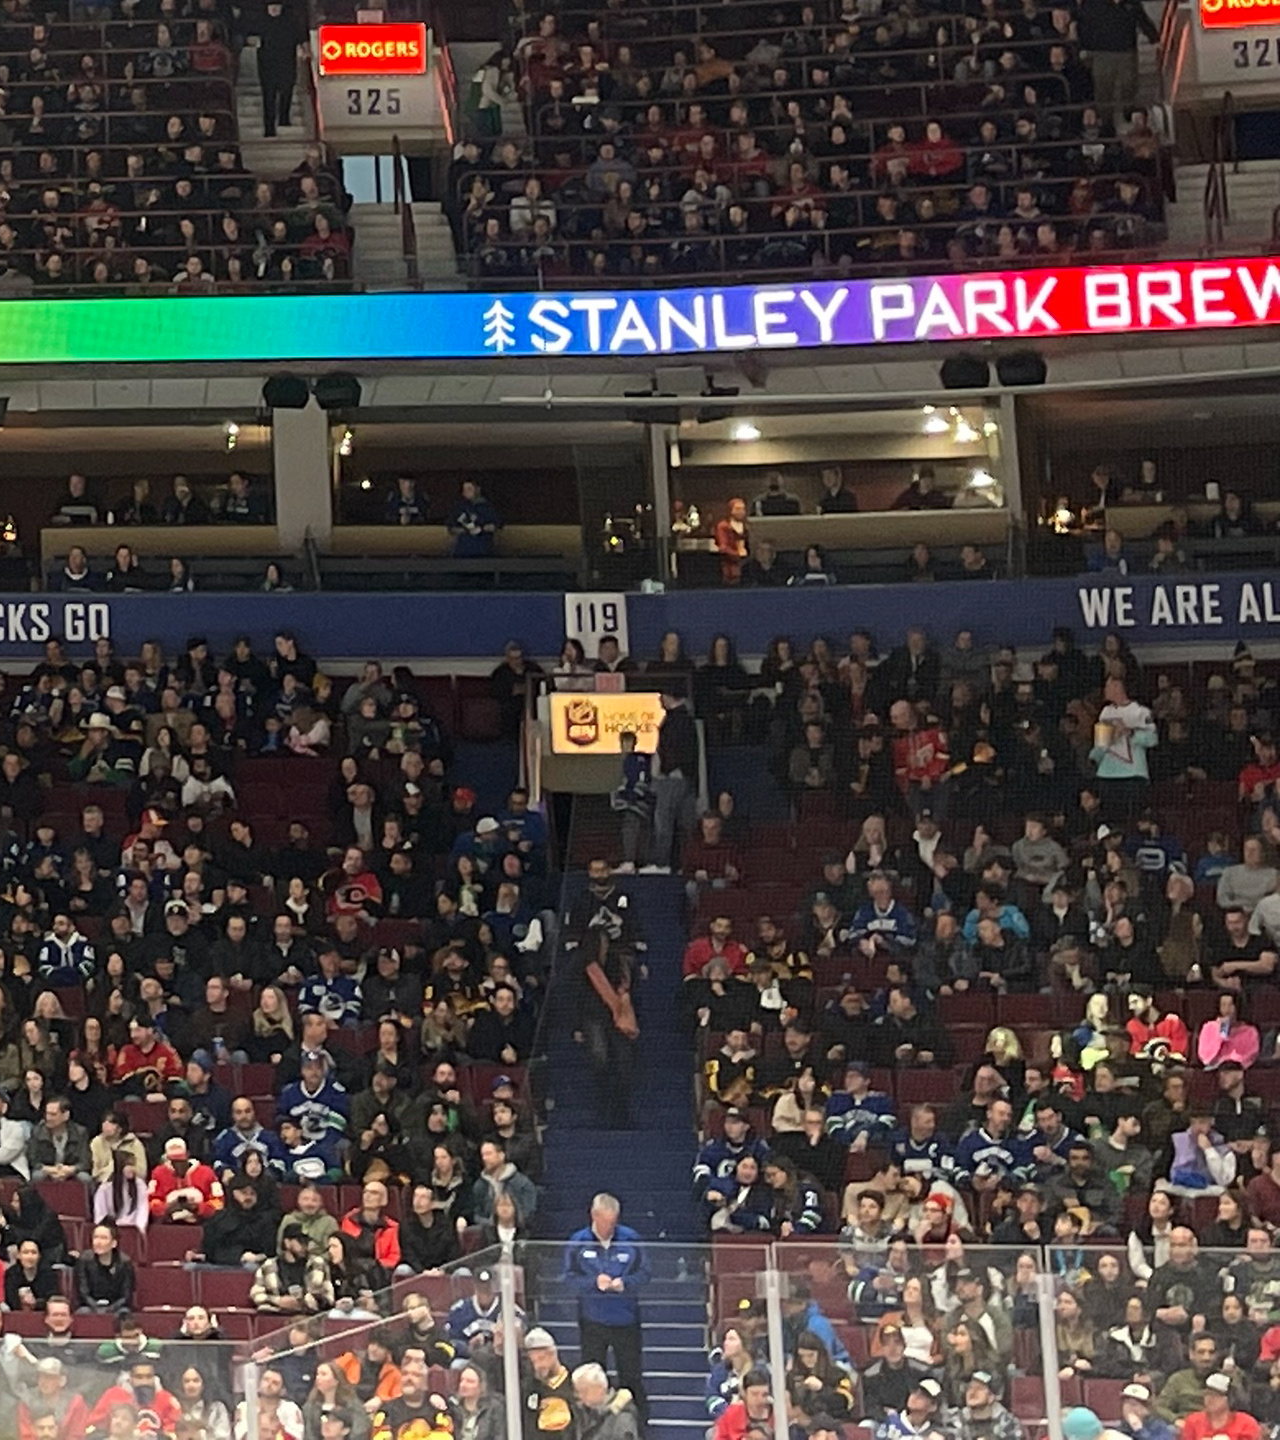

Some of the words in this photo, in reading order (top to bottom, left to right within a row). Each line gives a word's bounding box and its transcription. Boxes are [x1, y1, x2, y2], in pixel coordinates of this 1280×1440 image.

[345, 40, 419, 58] ROGERS
[347, 88, 401, 116] 325
[527, 287, 849, 352] STANLEY
[870, 276, 1061, 341] PARK
[63, 603, 110, 642] GO
[575, 602, 619, 633] 119
[1078, 586, 1136, 628] WE
[1151, 583, 1223, 627] ARE
